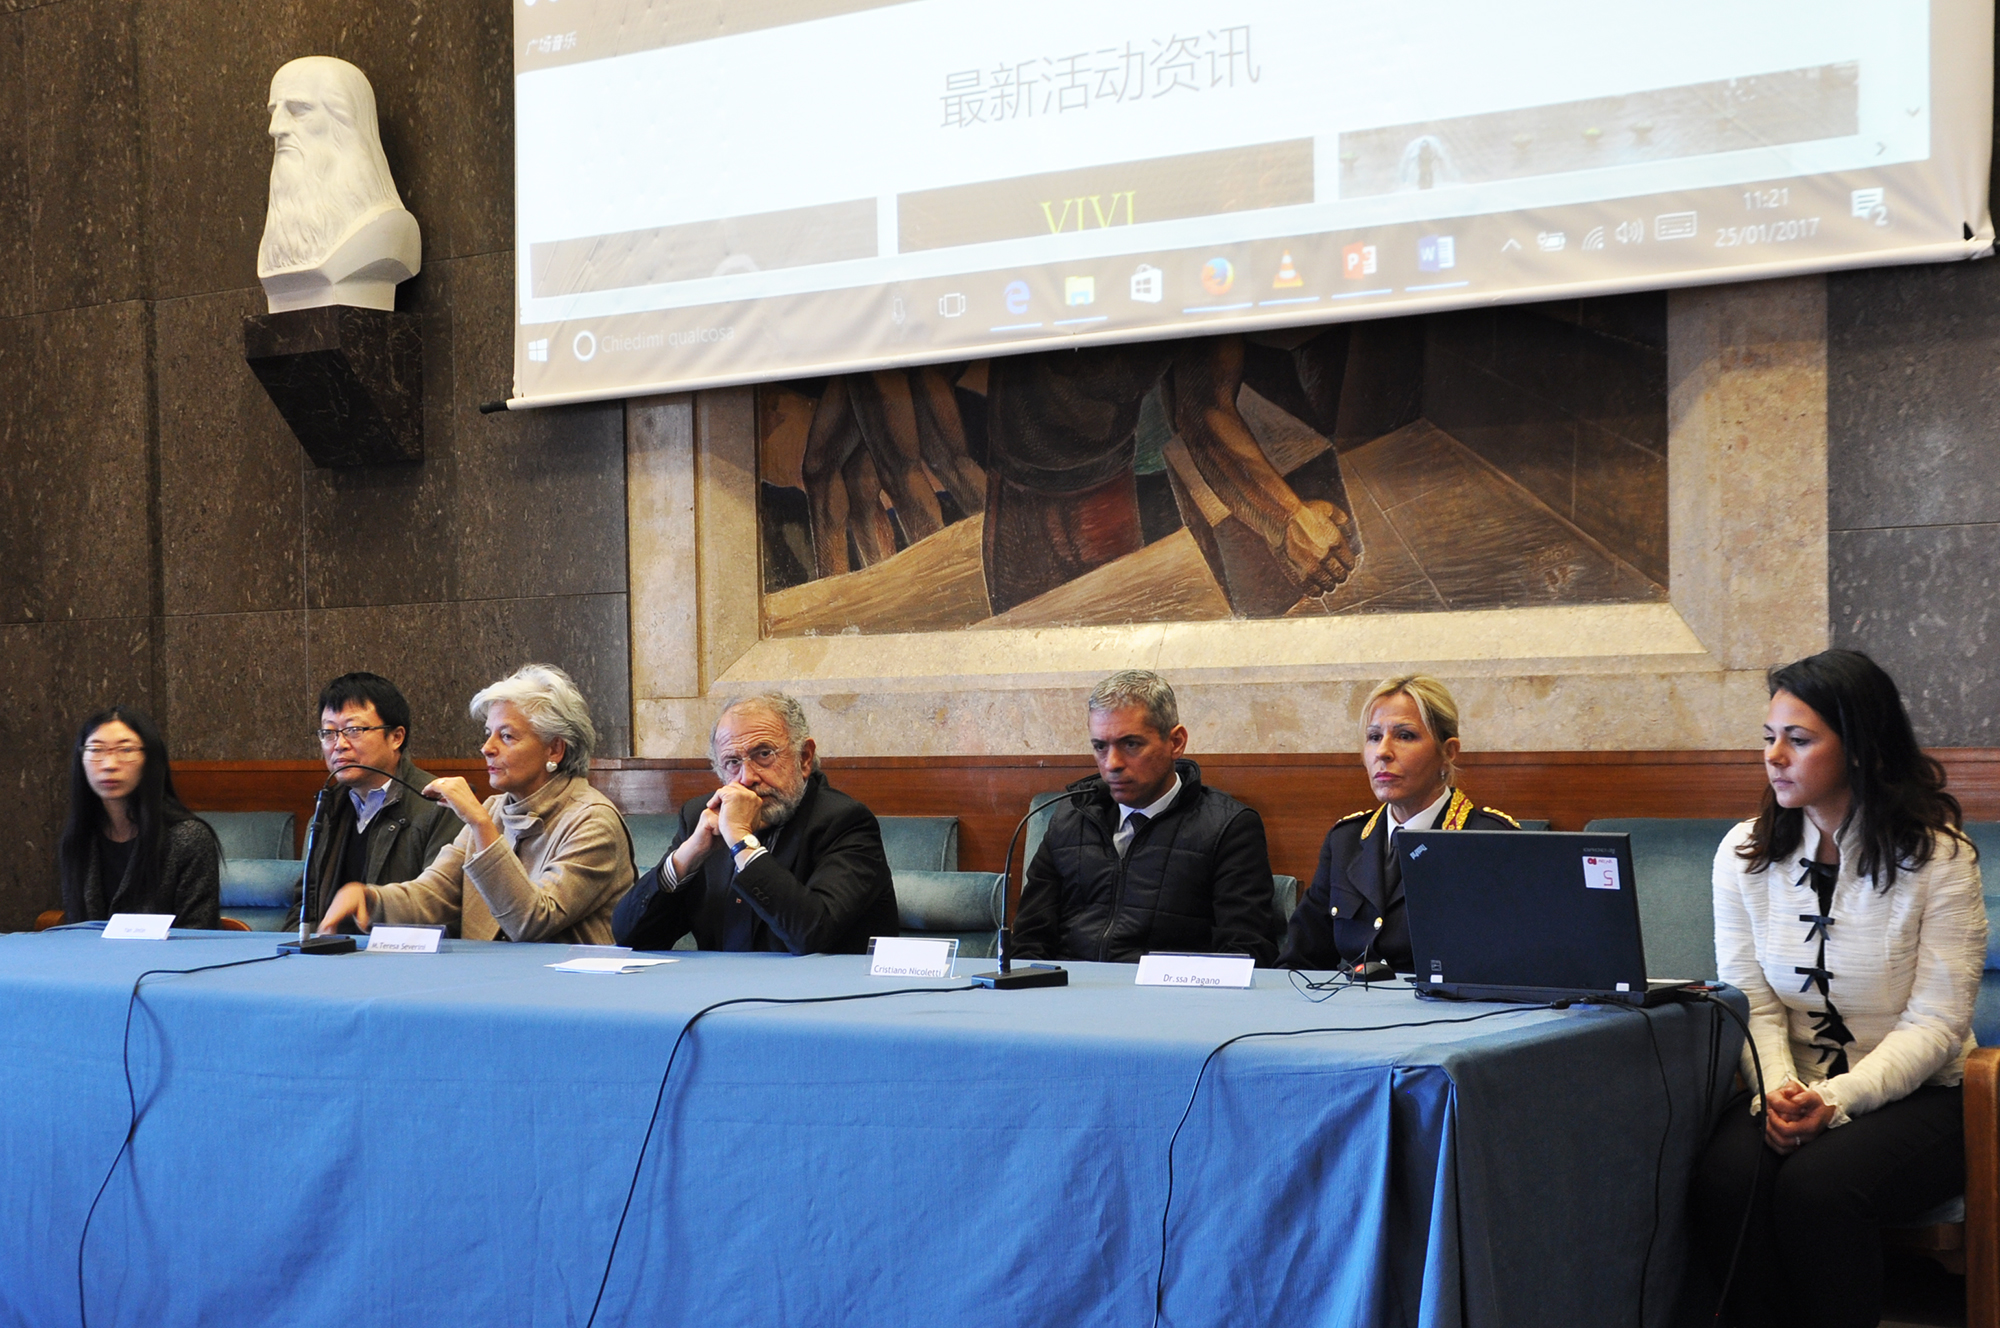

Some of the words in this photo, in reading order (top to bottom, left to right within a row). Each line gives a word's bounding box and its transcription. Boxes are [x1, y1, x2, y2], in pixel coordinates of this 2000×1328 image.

[939, 24, 1261, 129] 最新活动资讯
[1743, 187, 1790, 211] 11:21
[1040, 190, 1136, 234] VIVI
[1875, 205, 1888, 226] 2
[1714, 217, 1820, 248] 25/01/2017
[601, 330, 664, 353] Chiedimi
[668, 326, 735, 349] qualcosa
[873, 964, 907, 975] Cristiano
[908, 967, 942, 977] Nicoletti
[1163, 973, 1188, 983] Dr.ssa
[1190, 975, 1221, 986] Pagano
